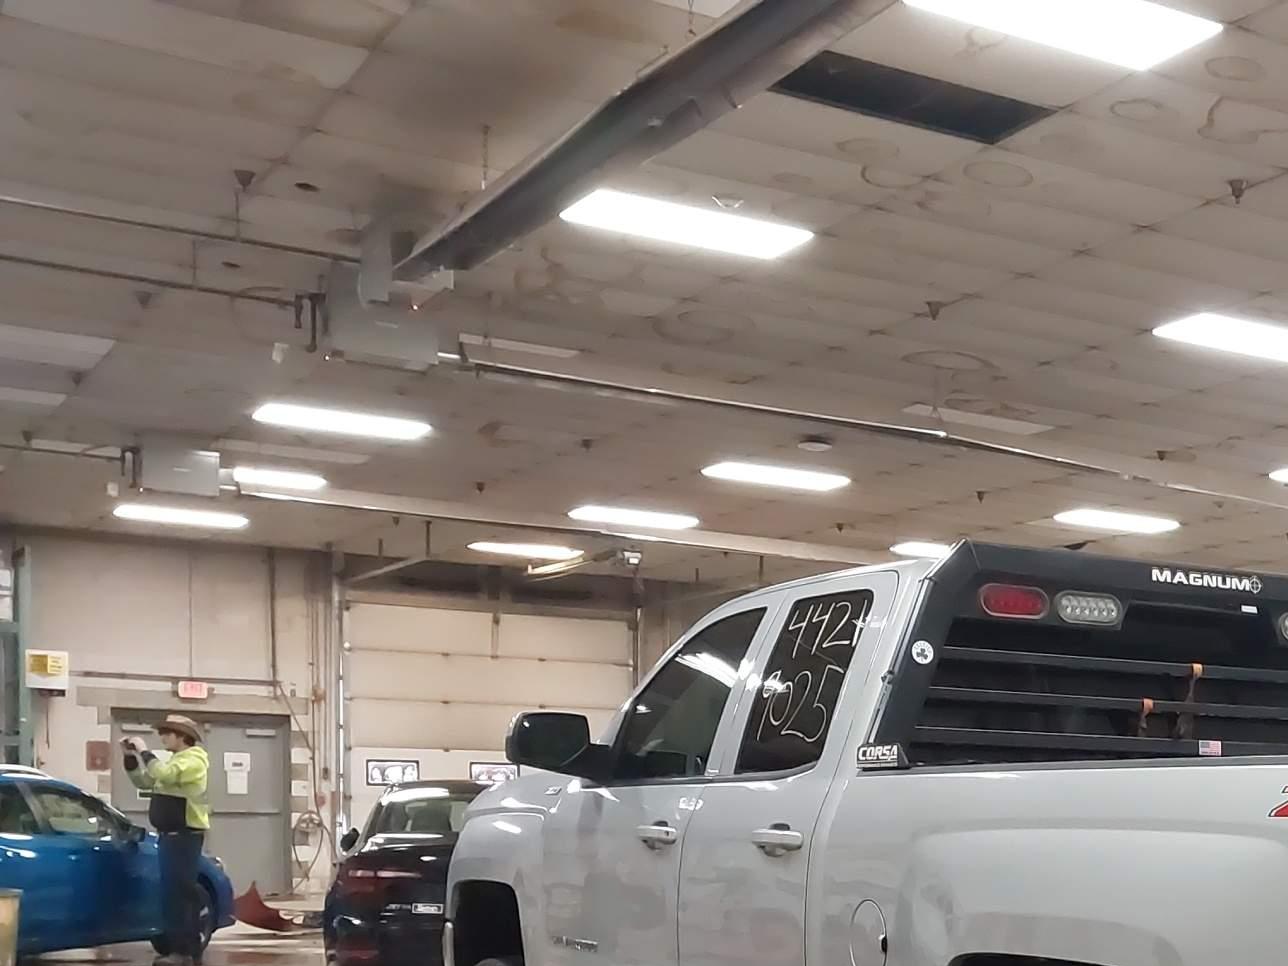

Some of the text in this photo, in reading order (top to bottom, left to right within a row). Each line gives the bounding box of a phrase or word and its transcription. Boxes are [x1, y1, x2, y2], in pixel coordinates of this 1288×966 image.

[1151, 568, 1250, 592] MAGNUM
[788, 600, 868, 659] 4421
[858, 744, 898, 761] CORSA
